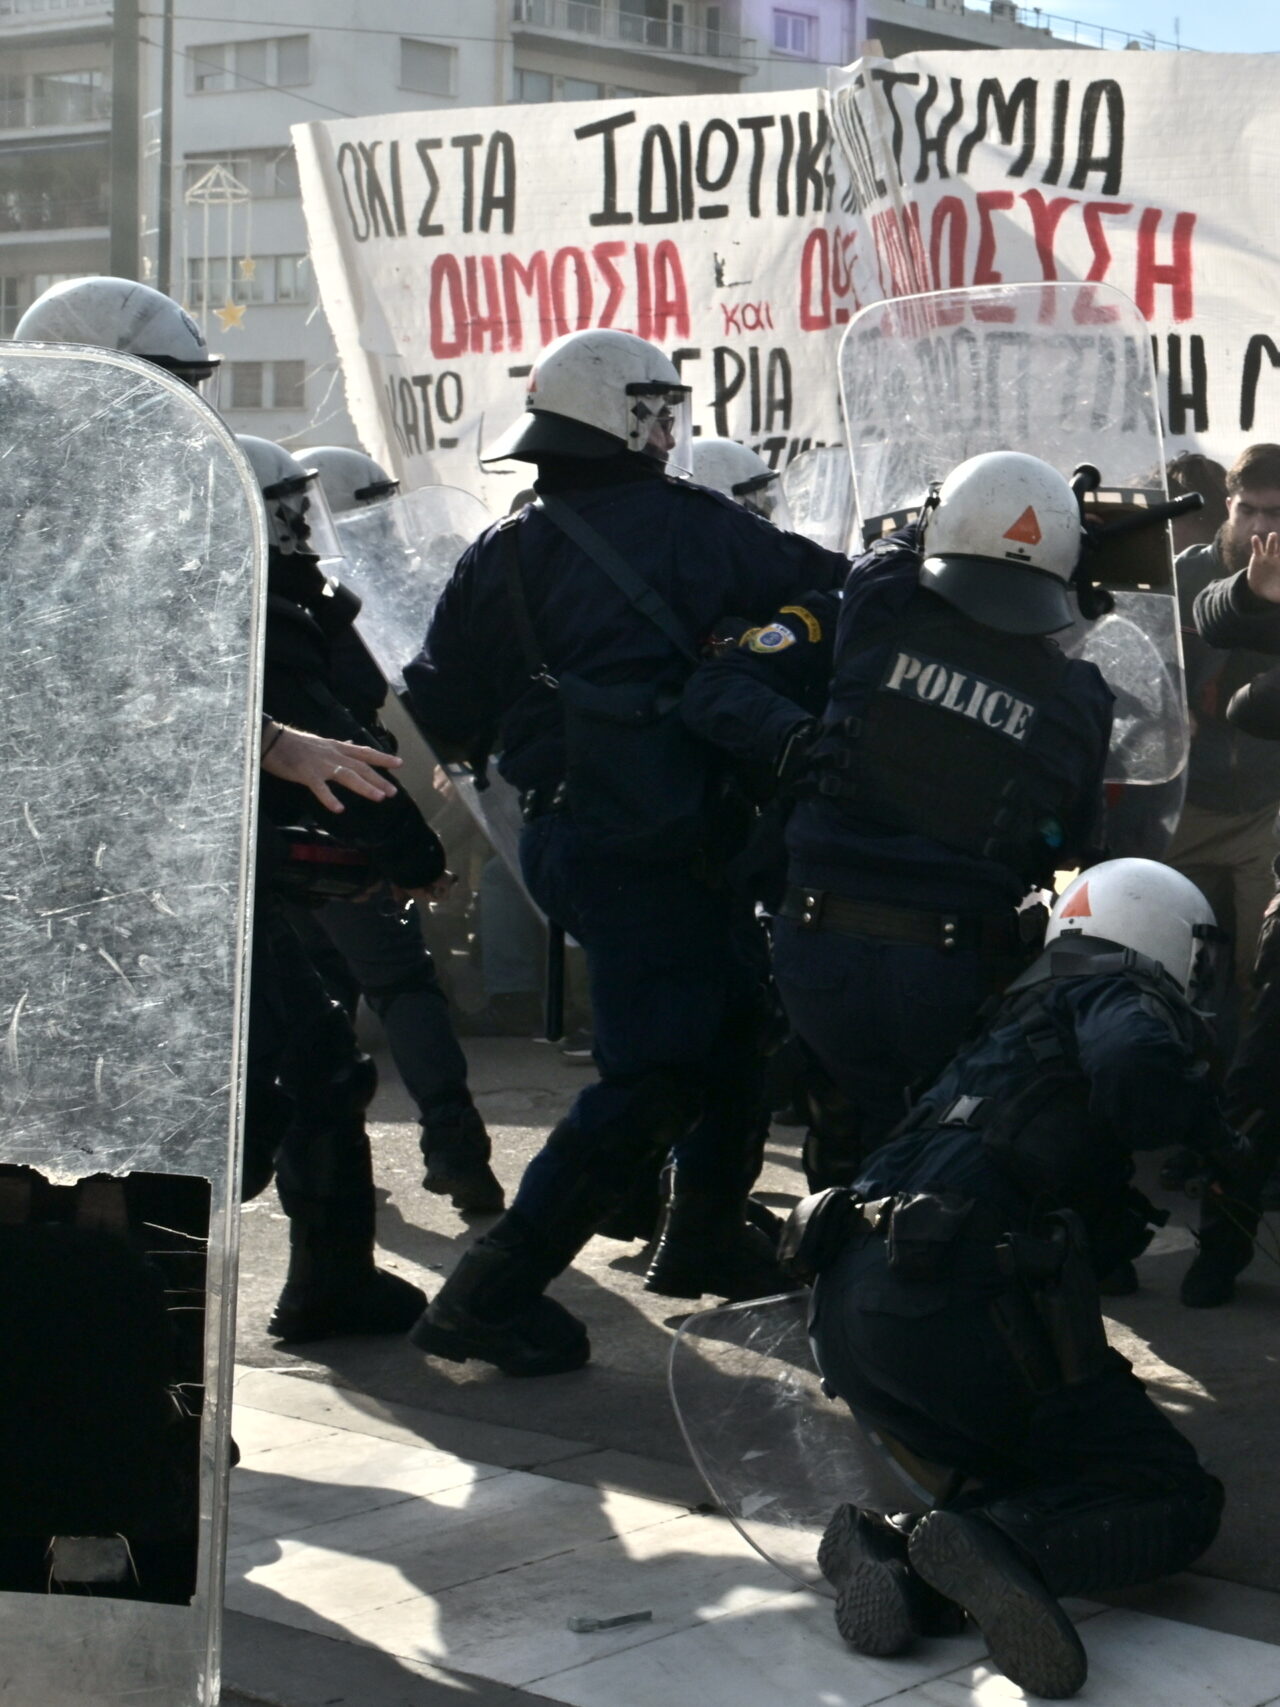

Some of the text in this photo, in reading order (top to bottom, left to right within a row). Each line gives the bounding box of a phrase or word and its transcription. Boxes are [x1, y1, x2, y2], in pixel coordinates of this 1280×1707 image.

[338, 140, 407, 242] ΟΧΙ
[416, 131, 516, 237] ΣΤΑ
[429, 239, 691, 359] ΔΗΜΟΣΙΑ
[385, 370, 465, 458] ΚΑΤΩ
[885, 652, 1035, 741] POLICE
